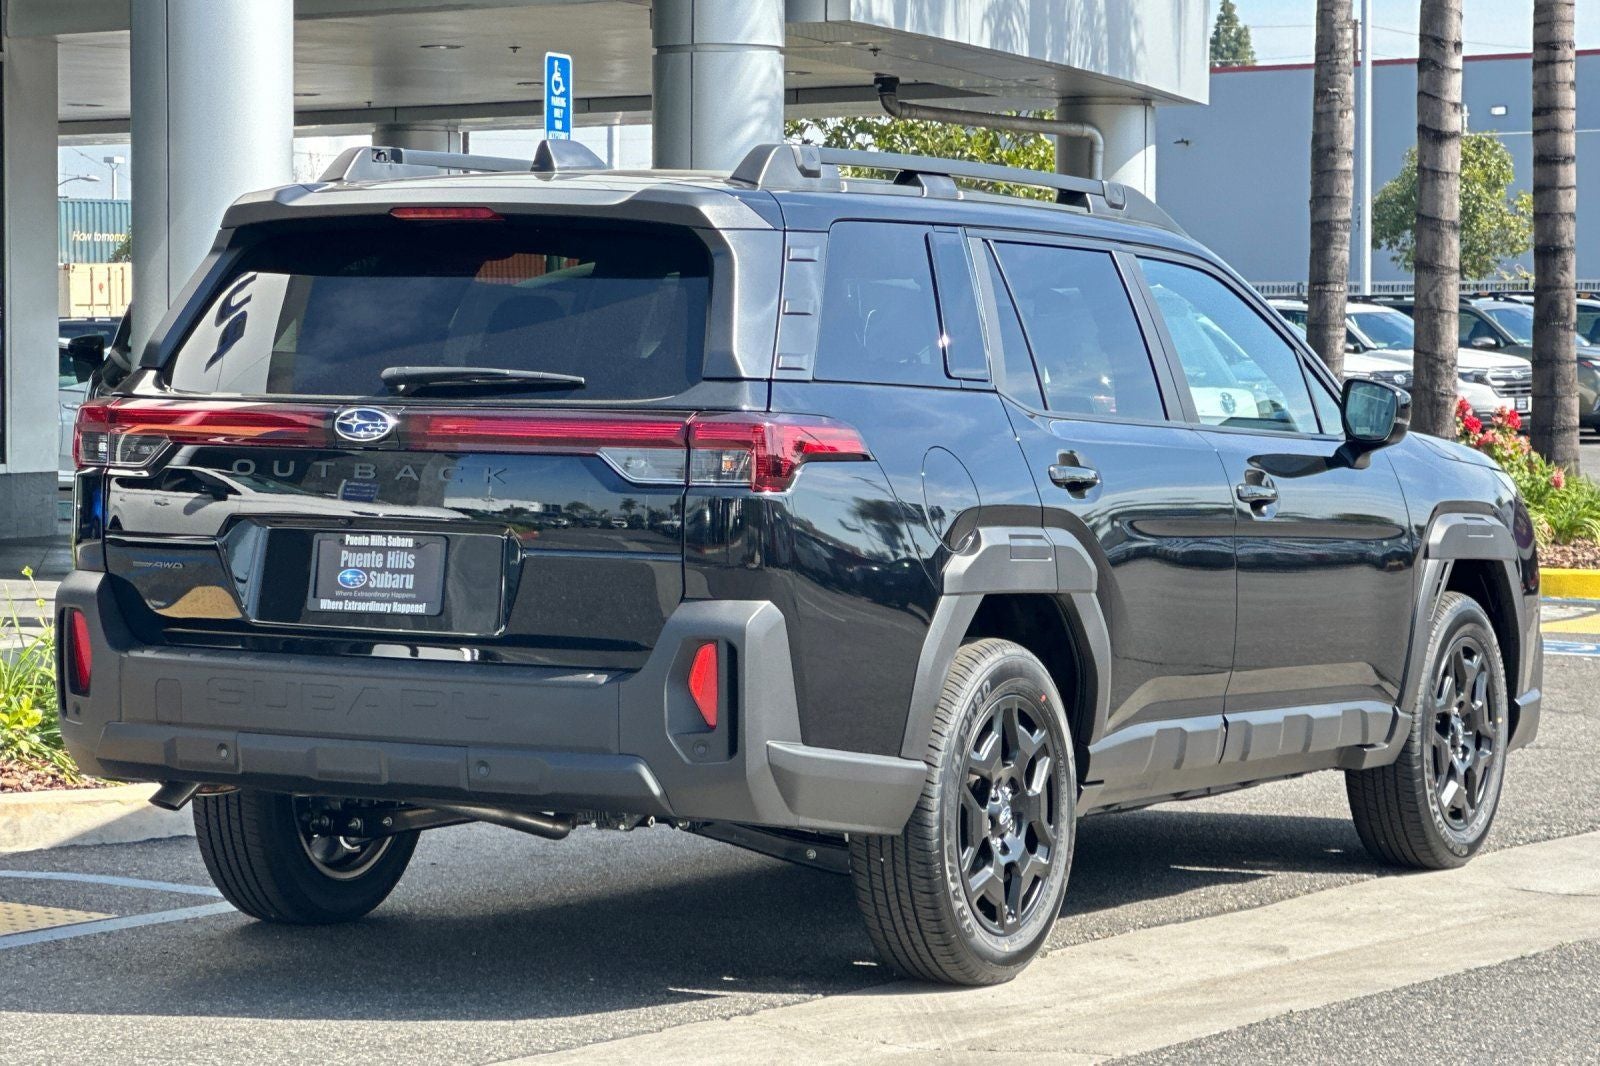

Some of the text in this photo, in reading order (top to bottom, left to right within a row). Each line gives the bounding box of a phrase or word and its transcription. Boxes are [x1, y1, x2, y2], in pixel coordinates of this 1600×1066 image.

[72, 231, 92, 241] How
[231, 458, 507, 485] OUTBACK
[345, 534, 414, 548] Puente Hills Subaru
[340, 550, 415, 569] Puente Hills
[368, 571, 415, 589] Subaru
[353, 591, 390, 599] Extraordinary
[320, 599, 426, 614] Where Extraordinary Happens!
[205, 677, 499, 721] SUBARU
